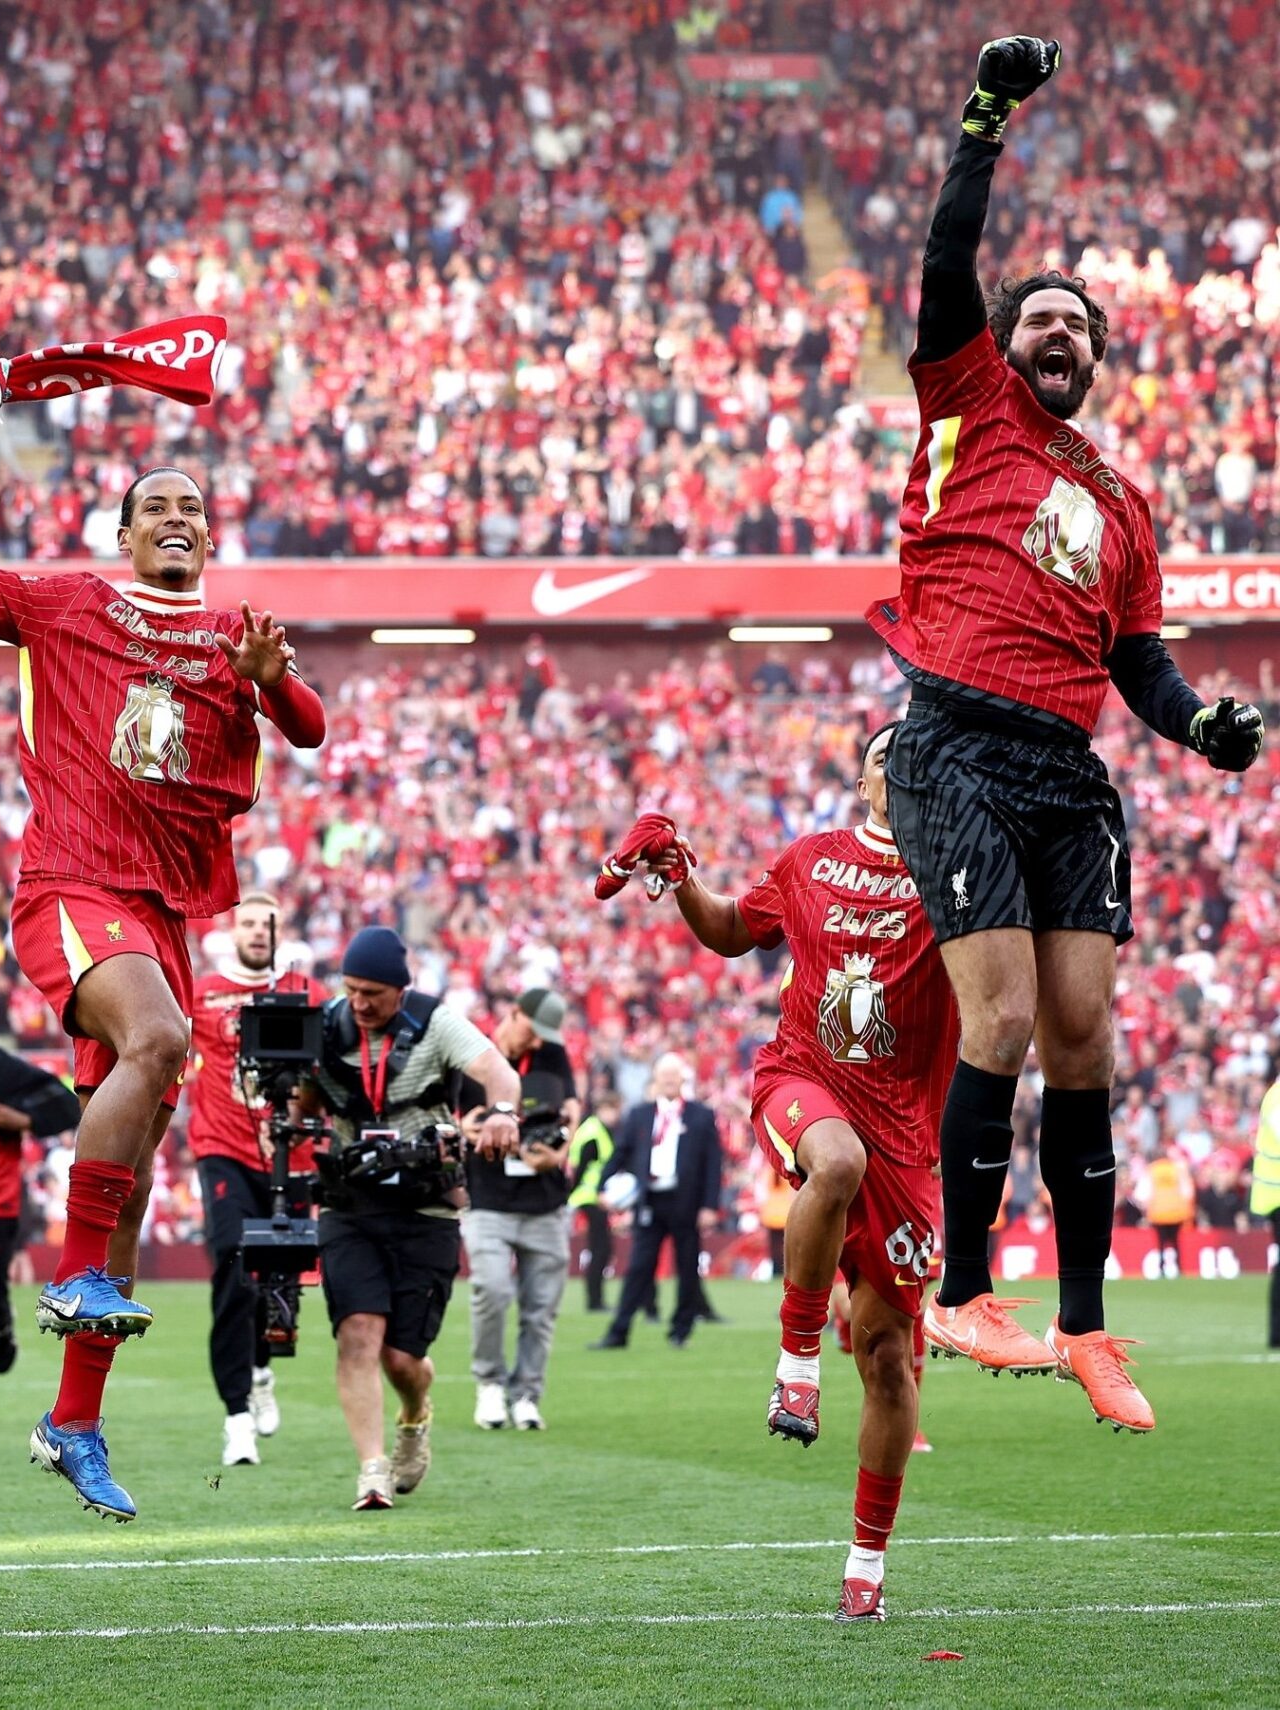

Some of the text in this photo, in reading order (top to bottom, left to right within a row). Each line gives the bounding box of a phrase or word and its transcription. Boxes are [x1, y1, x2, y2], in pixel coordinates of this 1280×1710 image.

[105, 600, 218, 649] CHAMPIO
[811, 857, 919, 899] CHAMPIO
[823, 904, 907, 940] 24/25
